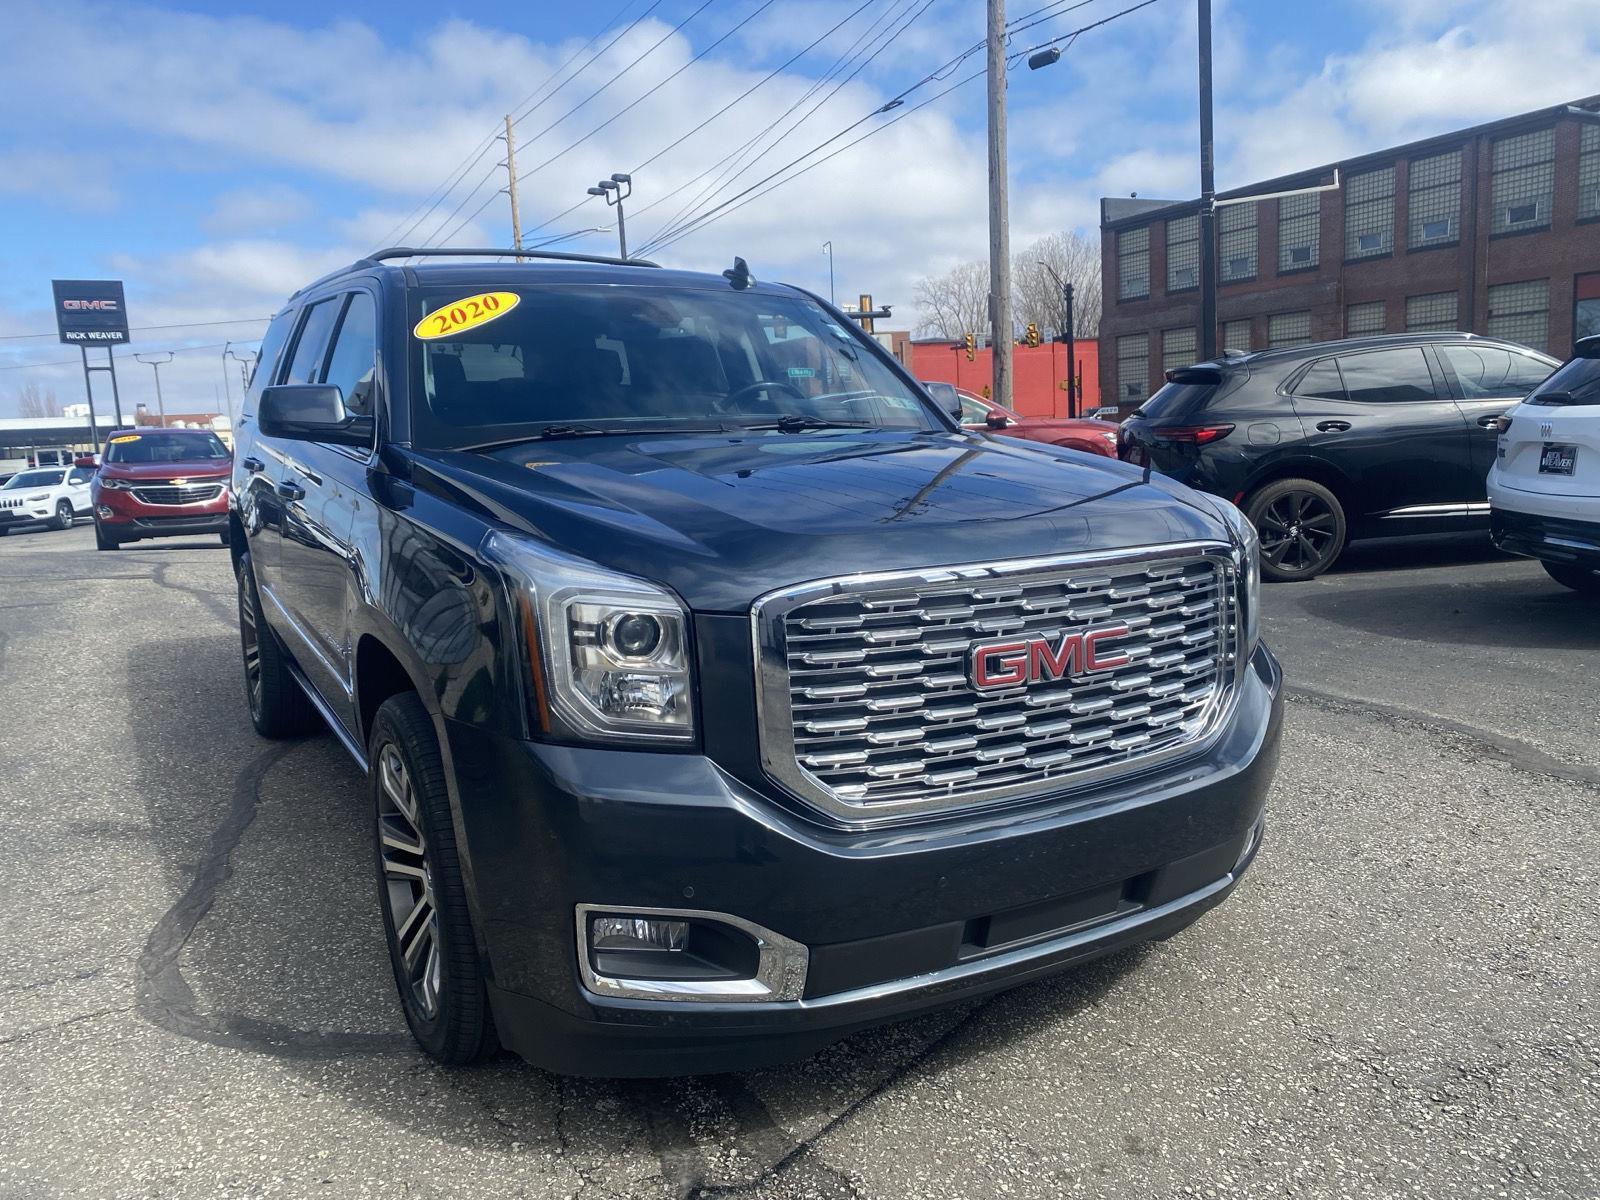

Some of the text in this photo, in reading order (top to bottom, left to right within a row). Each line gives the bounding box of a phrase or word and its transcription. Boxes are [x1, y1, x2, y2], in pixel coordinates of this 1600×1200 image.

[63, 300, 117, 310] GMC
[433, 295, 500, 334] 2020
[65, 331, 123, 339] RICK WEAVER
[1541, 458, 1573, 468] WEAVER
[972, 624, 1131, 691] GMC
